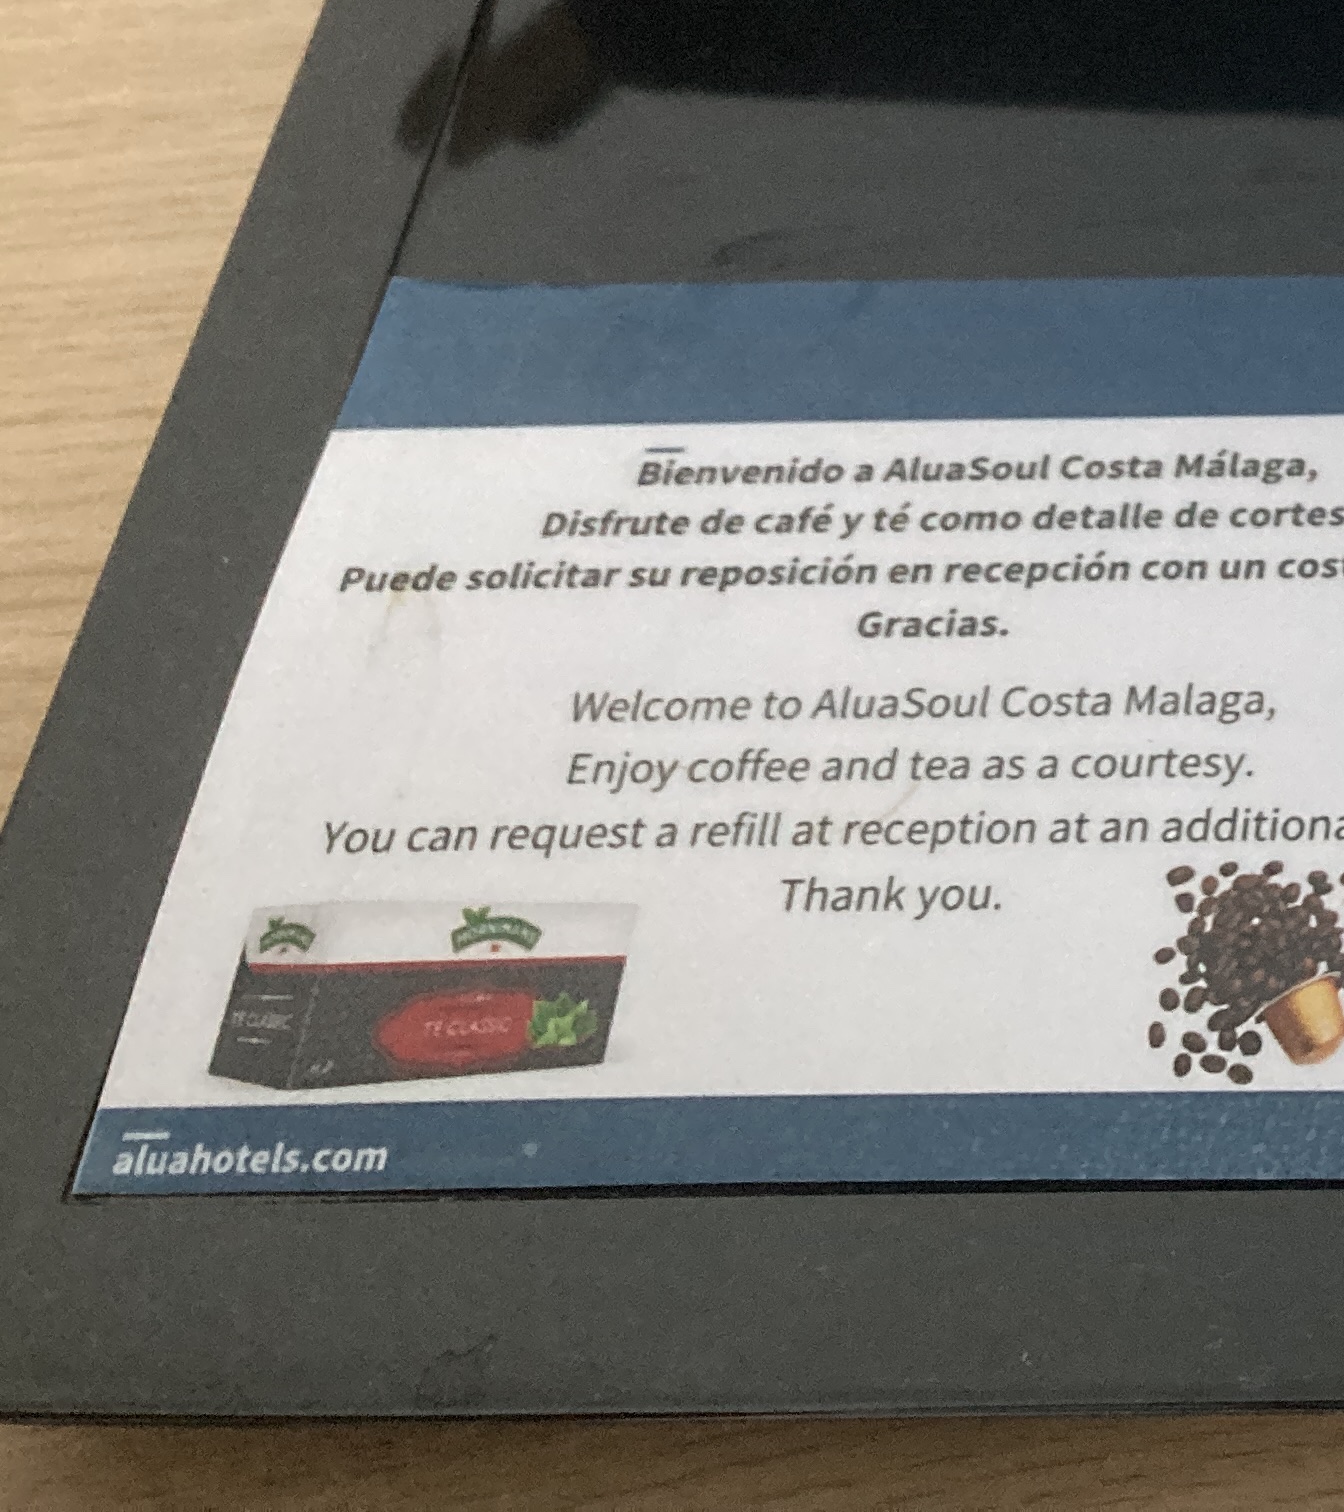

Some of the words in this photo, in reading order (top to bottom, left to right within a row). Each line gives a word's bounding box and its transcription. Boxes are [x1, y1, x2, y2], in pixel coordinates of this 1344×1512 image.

[636, 456, 846, 488] Bienvenido
[853, 463, 875, 484] a
[882, 453, 1051, 483] AluaSoul
[1059, 454, 1164, 481] Costa
[1173, 448, 1318, 486] Málaga,
[540, 508, 691, 539] Disfrute
[699, 507, 746, 536] de
[753, 502, 835, 535] café
[838, 512, 866, 541] y
[873, 501, 912, 533] té
[919, 510, 1023, 533] como
[1031, 501, 1164, 531] detalle
[1173, 501, 1220, 529] de
[339, 563, 458, 593] Puede
[464, 560, 623, 591] solicitar
[627, 566, 672, 588] su
[679, 553, 878, 593] reposición
[887, 563, 934, 585] en
[943, 549, 1132, 590] recepción
[1141, 559, 1209, 582] con
[1219, 559, 1267, 581] un
[856, 607, 1009, 639] Gracias.
[572, 688, 753, 723] Welcome
[763, 691, 803, 721] to
[809, 684, 991, 720] AluaSoul
[1000, 685, 1112, 718] Costa
[1124, 681, 1276, 725] Malaga,
[566, 750, 680, 795] Enjoy
[686, 746, 811, 784] coffee
[821, 746, 900, 782] and
[910, 751, 971, 782] tea
[982, 755, 1026, 781] as
[1036, 754, 1059, 780] a
[1071, 748, 1254, 788] courtesy.
[325, 820, 396, 855] You
[406, 825, 478, 853] can
[489, 817, 648, 859] request
[654, 822, 679, 849] a
[689, 810, 783, 848] refill
[791, 815, 834, 847] at
[842, 810, 1038, 854] reception
[1048, 812, 1091, 845] at
[1099, 817, 1149, 844] an
[780, 875, 907, 913] Thank
[914, 884, 1002, 921] you.
[112, 1141, 389, 1177] aluahotels.com
